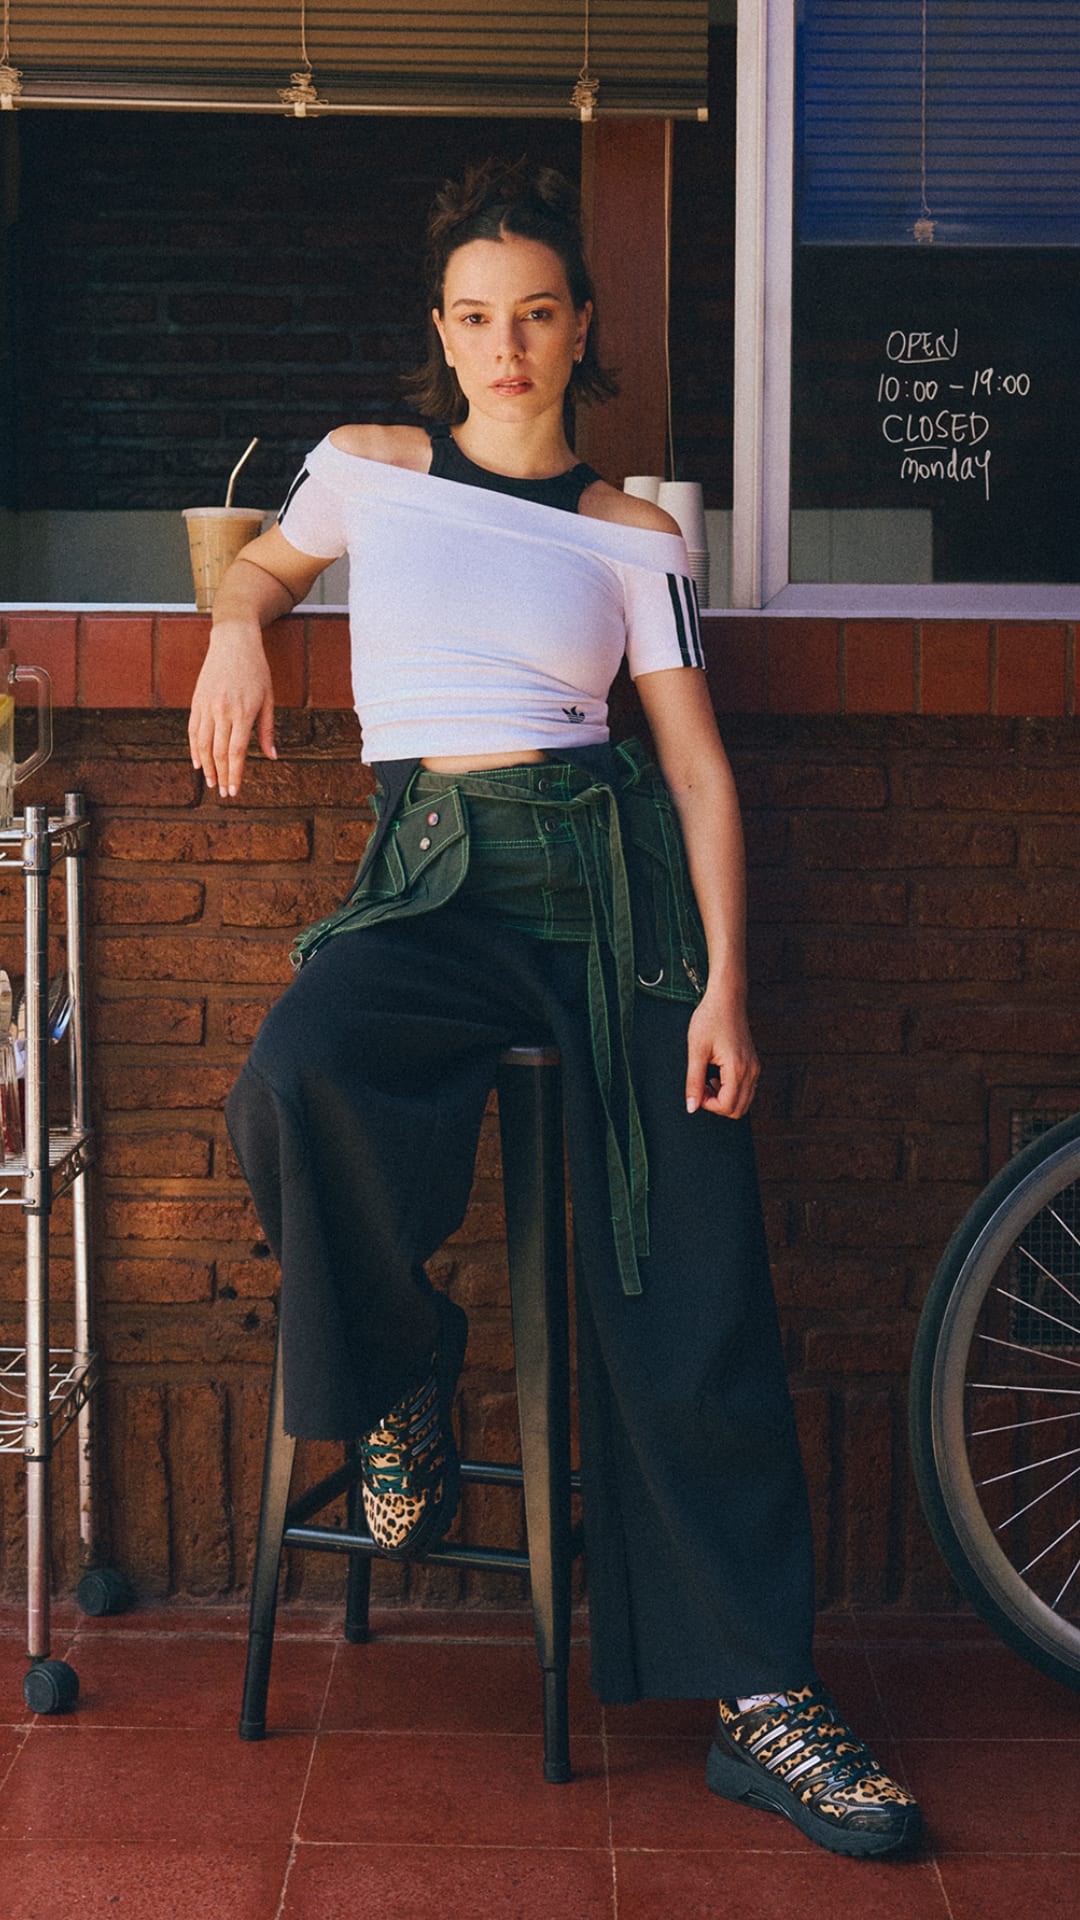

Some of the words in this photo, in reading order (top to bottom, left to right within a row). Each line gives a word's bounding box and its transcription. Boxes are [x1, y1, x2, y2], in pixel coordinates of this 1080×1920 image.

[886, 328, 958, 360] OPEN
[877, 373, 939, 403] 10:00
[971, 367, 1031, 396] 19:00
[882, 410, 990, 446] CLOSED
[901, 448, 992, 501] monday
